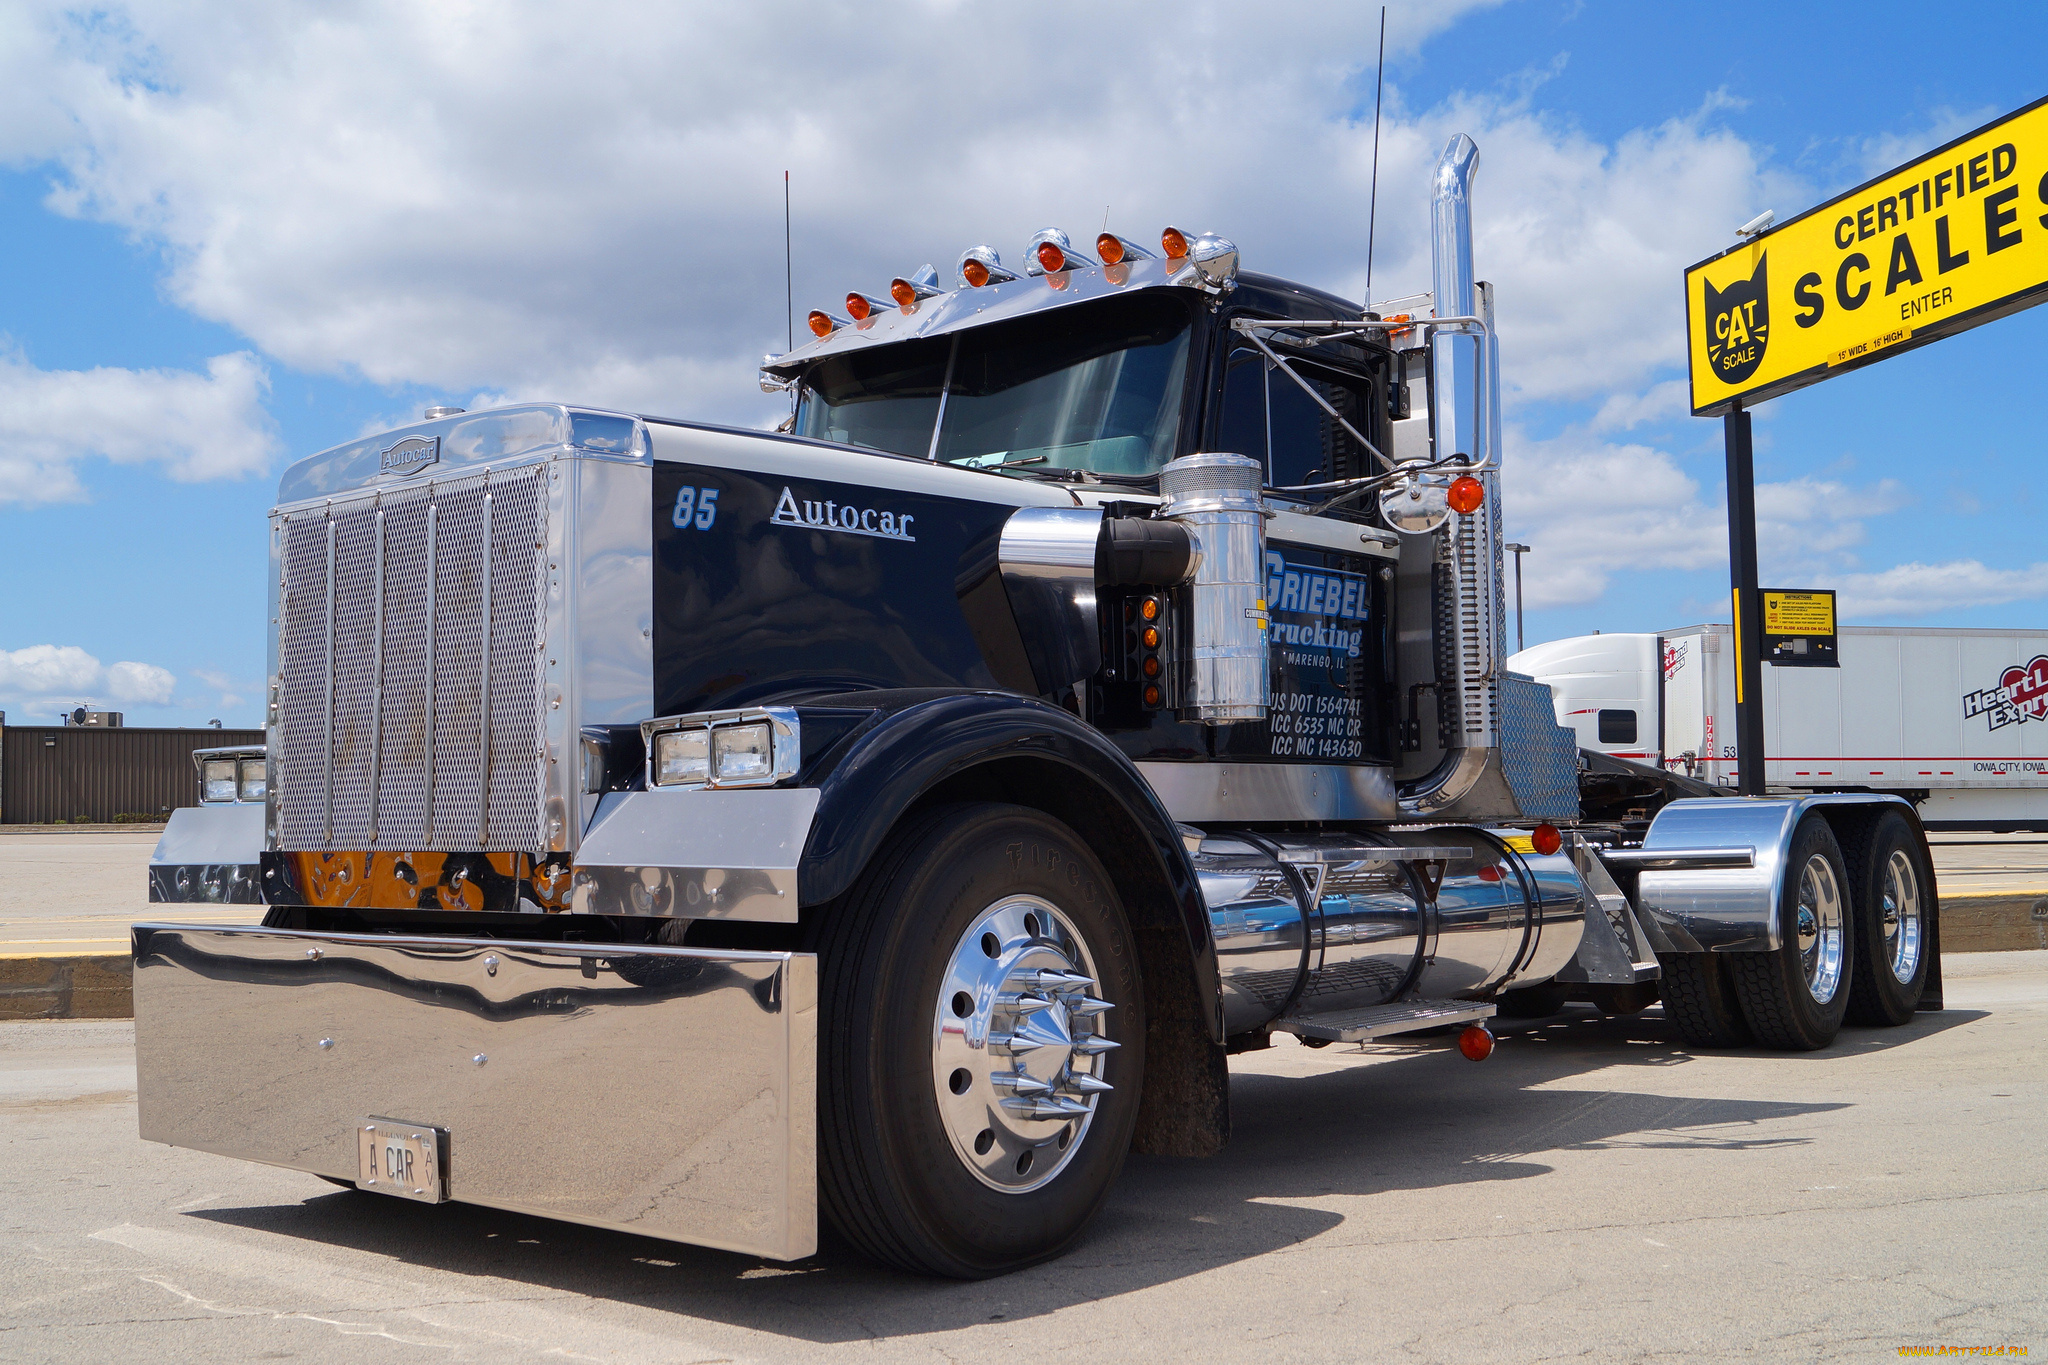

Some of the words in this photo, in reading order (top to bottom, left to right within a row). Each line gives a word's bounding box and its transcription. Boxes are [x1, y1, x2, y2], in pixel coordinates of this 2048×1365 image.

[1834, 142, 2017, 249] CERTIFIED
[1901, 286, 1953, 320] ENTER
[1715, 299, 1757, 350] CAT
[1723, 346, 1755, 370] SCALE
[1838, 350, 1846, 360] 15'
[1848, 343, 1867, 357] WIDE
[1883, 330, 1903, 344] HIGH
[382, 445, 434, 468] Autocar
[671, 485, 719, 531] 85
[771, 486, 915, 538] Autocar
[1266, 550, 1369, 621] GRIEBEL
[1287, 652, 1333, 670] MARENGO,
[1336, 657, 1344, 669] IL
[1271, 692, 1286, 711] US
[1290, 692, 1313, 713] DOT
[1316, 696, 1360, 716] 1564741
[1271, 713, 1291, 733] ICC
[1294, 715, 1324, 734] 6535
[1327, 717, 1344, 735] MC
[1346, 718, 1361, 737] CR
[1271, 736, 1292, 755] ICC
[1296, 737, 1315, 756] MC
[1318, 739, 1362, 757] 143630
[1723, 746, 1736, 758] 53
[1973, 762, 1996, 771] IOWA
[1998, 762, 2020, 773] CITY,
[2022, 762, 2045, 771] IOWA
[370, 1143, 378, 1176] A
[386, 1146, 414, 1182] CAR
